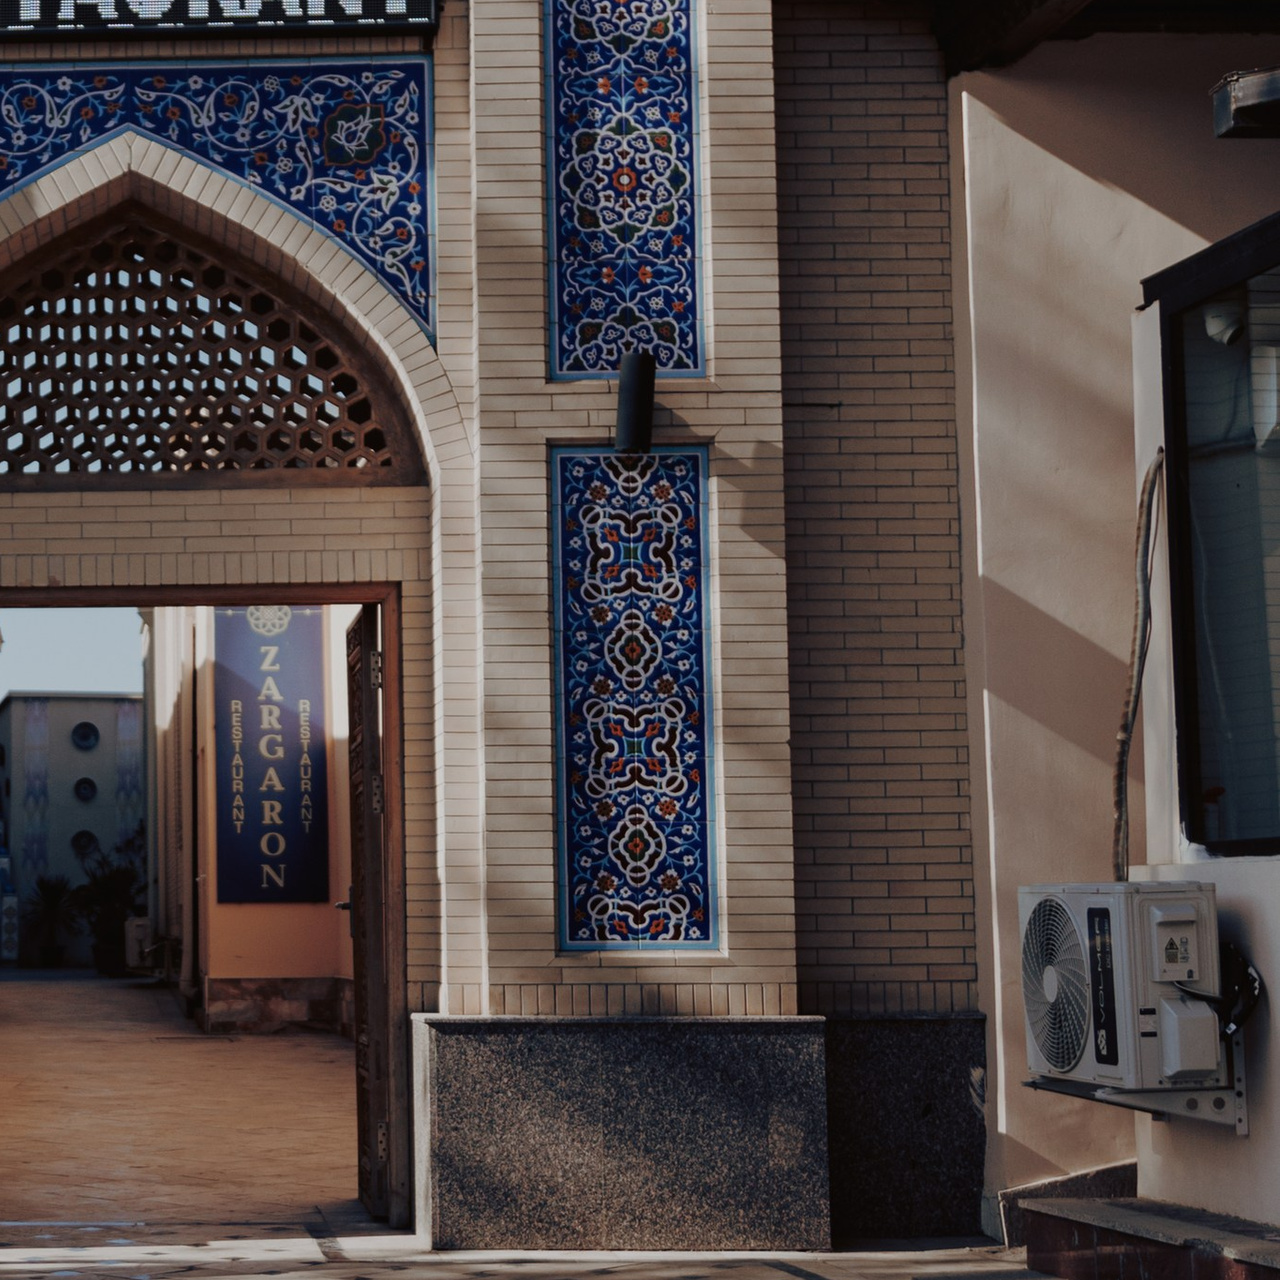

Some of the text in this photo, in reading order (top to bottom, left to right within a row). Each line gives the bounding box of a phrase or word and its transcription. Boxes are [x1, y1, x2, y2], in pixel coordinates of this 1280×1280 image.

[231, 699, 246, 834] RESTAURANT
[257, 645, 286, 888] ZARGARON
[298, 699, 313, 834] RESTAURANT
